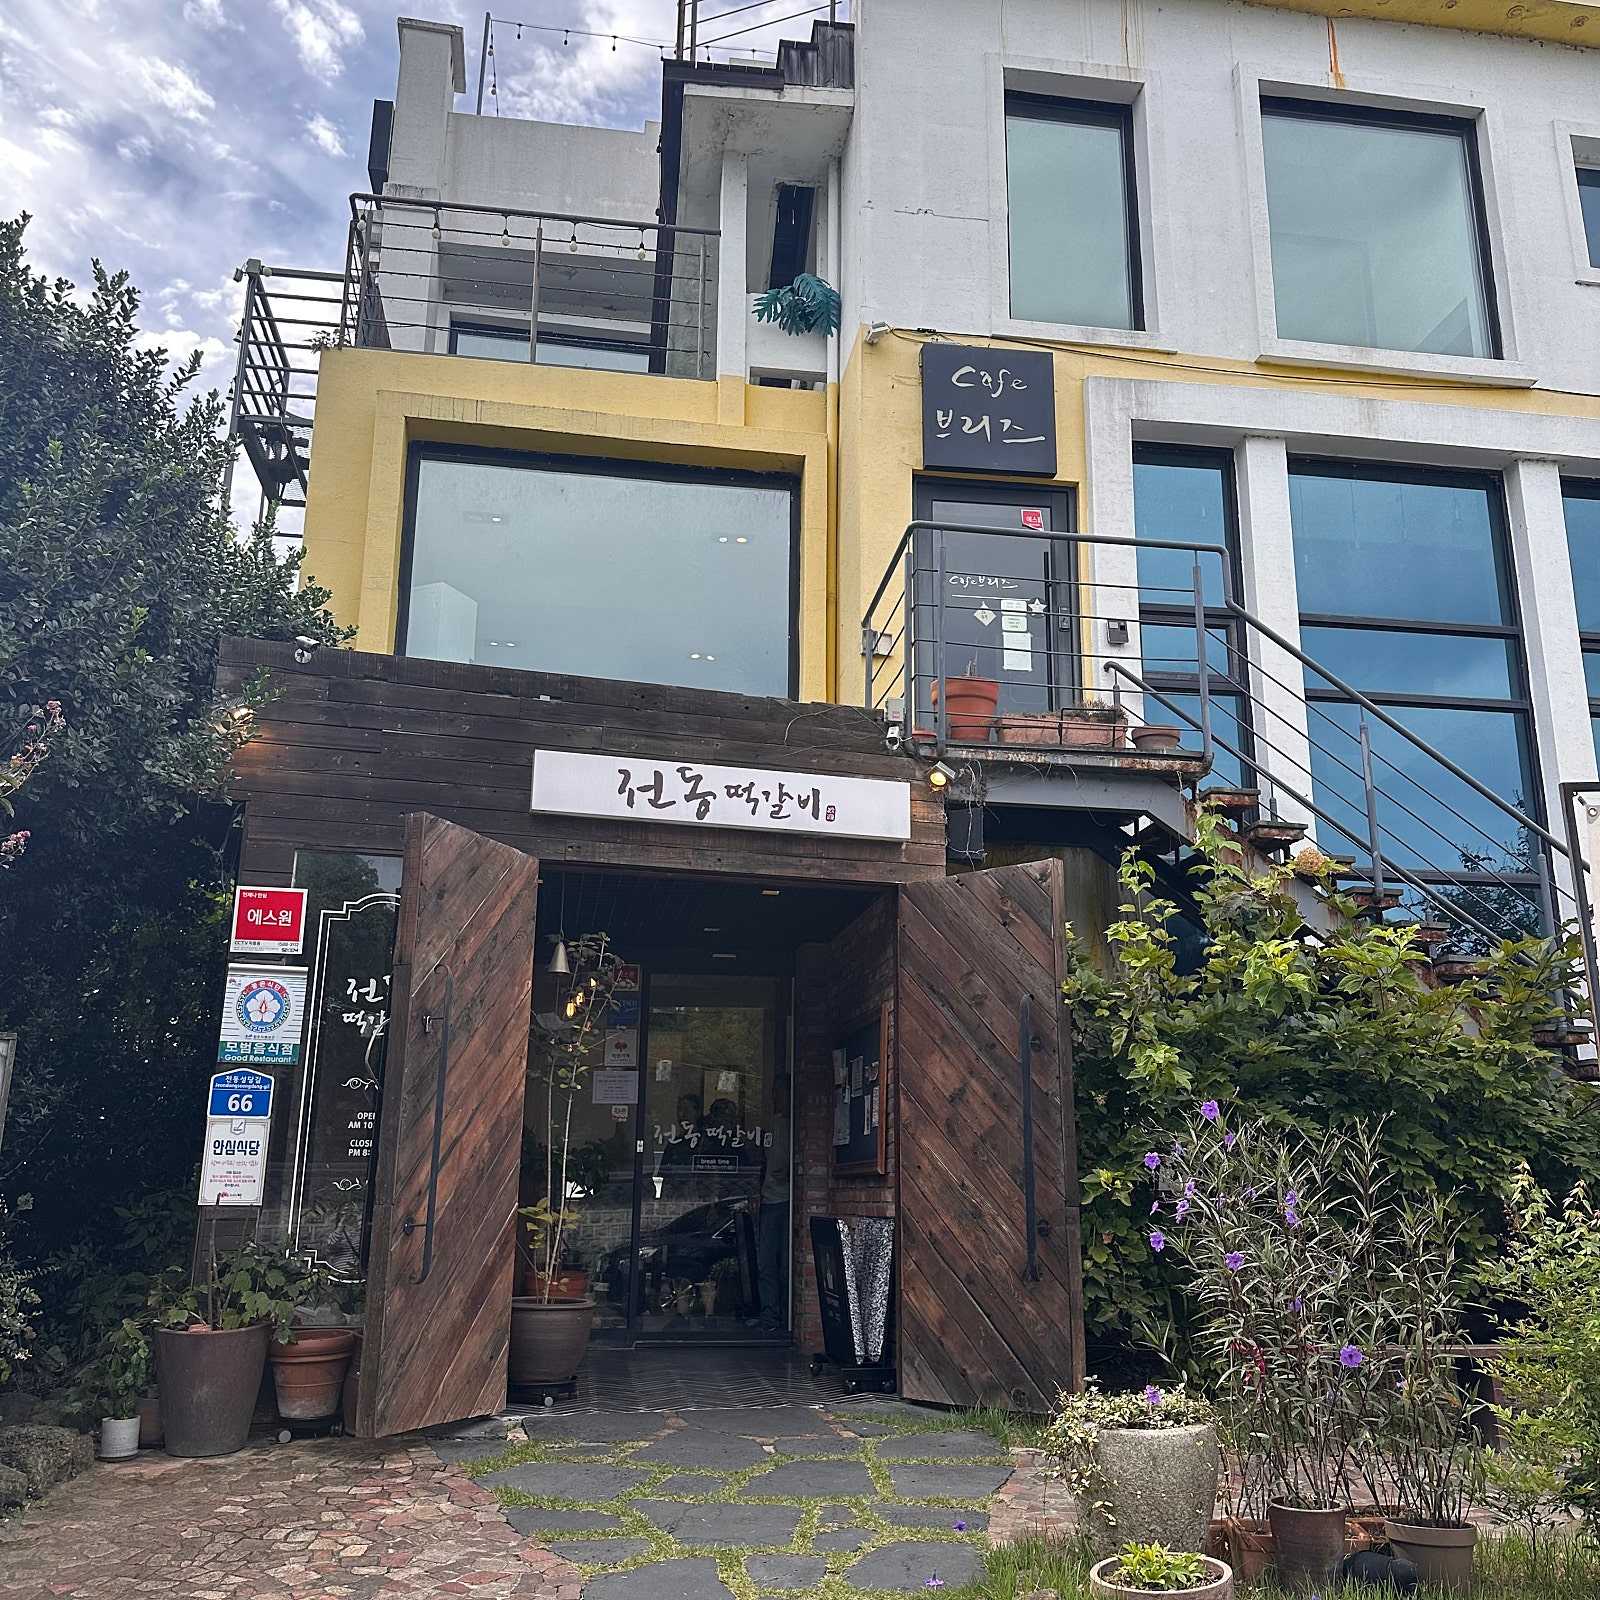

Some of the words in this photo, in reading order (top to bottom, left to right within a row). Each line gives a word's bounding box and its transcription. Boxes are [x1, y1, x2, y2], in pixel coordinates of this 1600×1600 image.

[951, 365, 1028, 398] Cafe
[936, 409, 1046, 442] 브리즈
[618, 766, 717, 820] 전동
[724, 781, 821, 820] 떡갈비
[247, 908, 293, 927] 에스원
[224, 1041, 294, 1056] 모범음식점
[224, 1054, 248, 1062] Good
[249, 1055, 292, 1063] Restaurant
[225, 1075, 262, 1084] 전동성당길
[227, 1093, 253, 1112] 66
[347, 1121, 361, 1129] AM
[653, 1120, 701, 1148] 전동
[706, 1124, 761, 1148] 떡갈비
[213, 1139, 261, 1156] 안심식당
